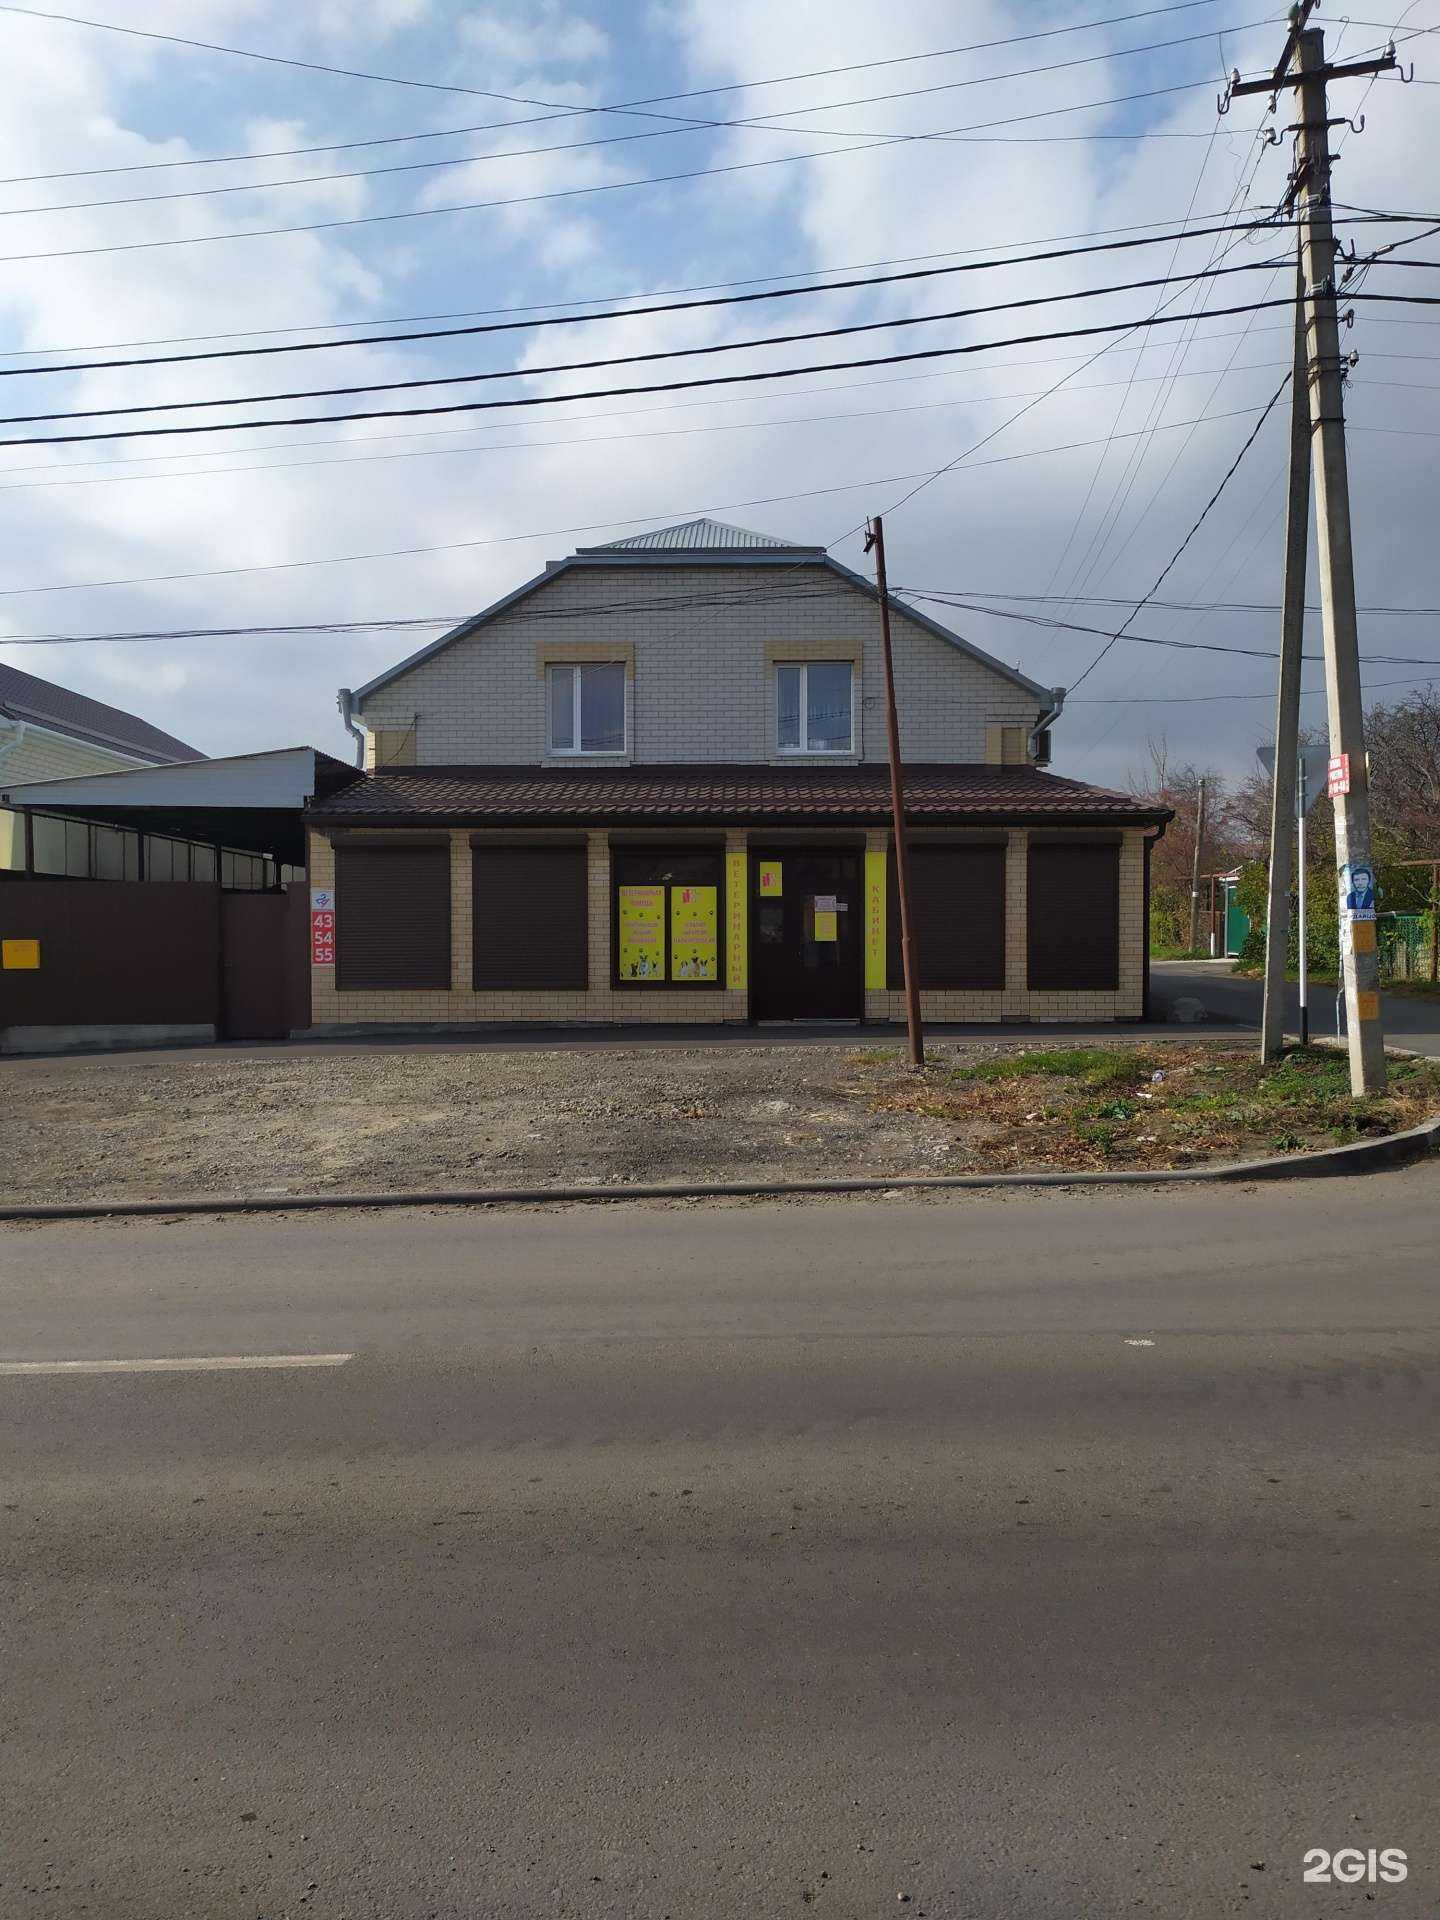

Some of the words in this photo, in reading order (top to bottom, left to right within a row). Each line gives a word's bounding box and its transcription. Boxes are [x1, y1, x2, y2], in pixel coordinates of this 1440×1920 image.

[313, 914, 333, 928] 43
[731, 858, 742, 984] ВЕТЕРИНАРНЫЙ
[871, 884, 881, 958] КАБИНЕТ
[314, 931, 333, 945] 54
[314, 948, 333, 962] 55
